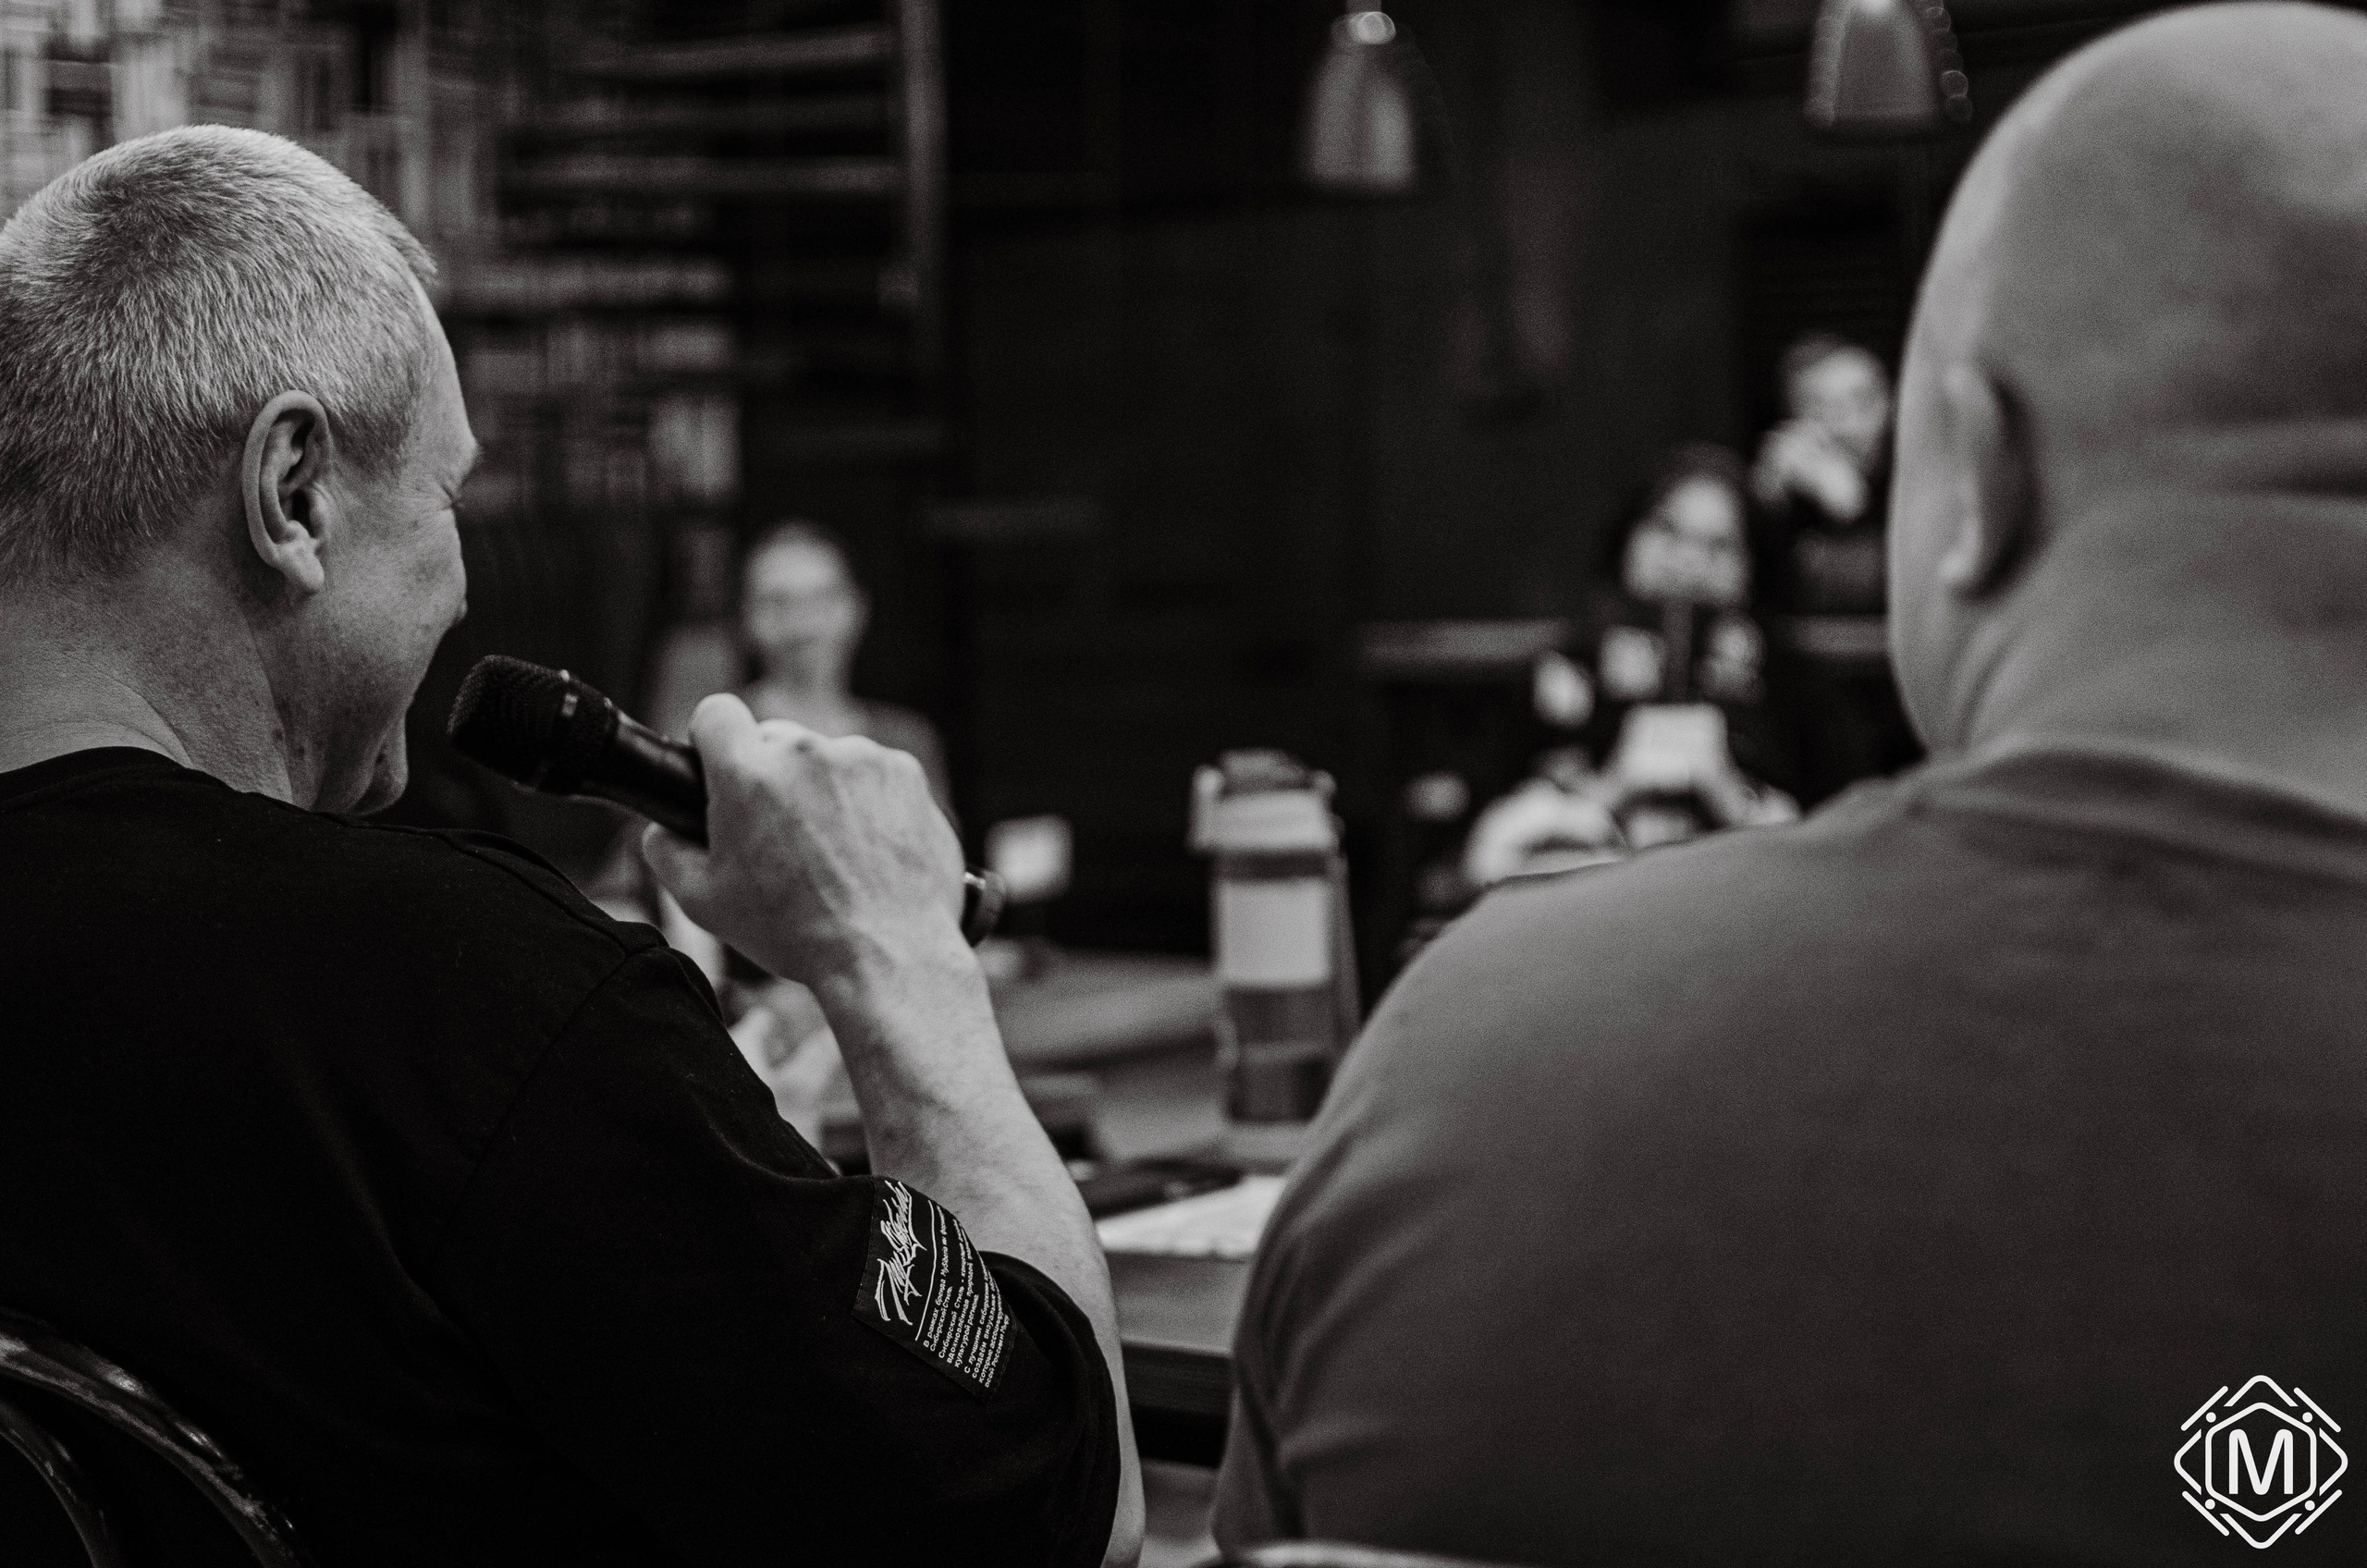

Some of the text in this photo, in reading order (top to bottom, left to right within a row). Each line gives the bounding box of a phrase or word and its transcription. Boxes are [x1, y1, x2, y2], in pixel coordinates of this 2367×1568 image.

[935, 1278, 946, 1306] бренда
[926, 1307, 939, 1339] рамках
[929, 1306, 947, 1352] Сибирский
[938, 1310, 958, 1358] Сибирский
[953, 1285, 964, 1308] Стиль
[946, 1298, 970, 1364] вдохновлённая
[923, 1340, 930, 1348] В
[954, 1324, 971, 1368] культурой
[968, 1326, 982, 1365] лучшими
[971, 1341, 987, 1378] создаём
[978, 1348, 993, 1383] которые
